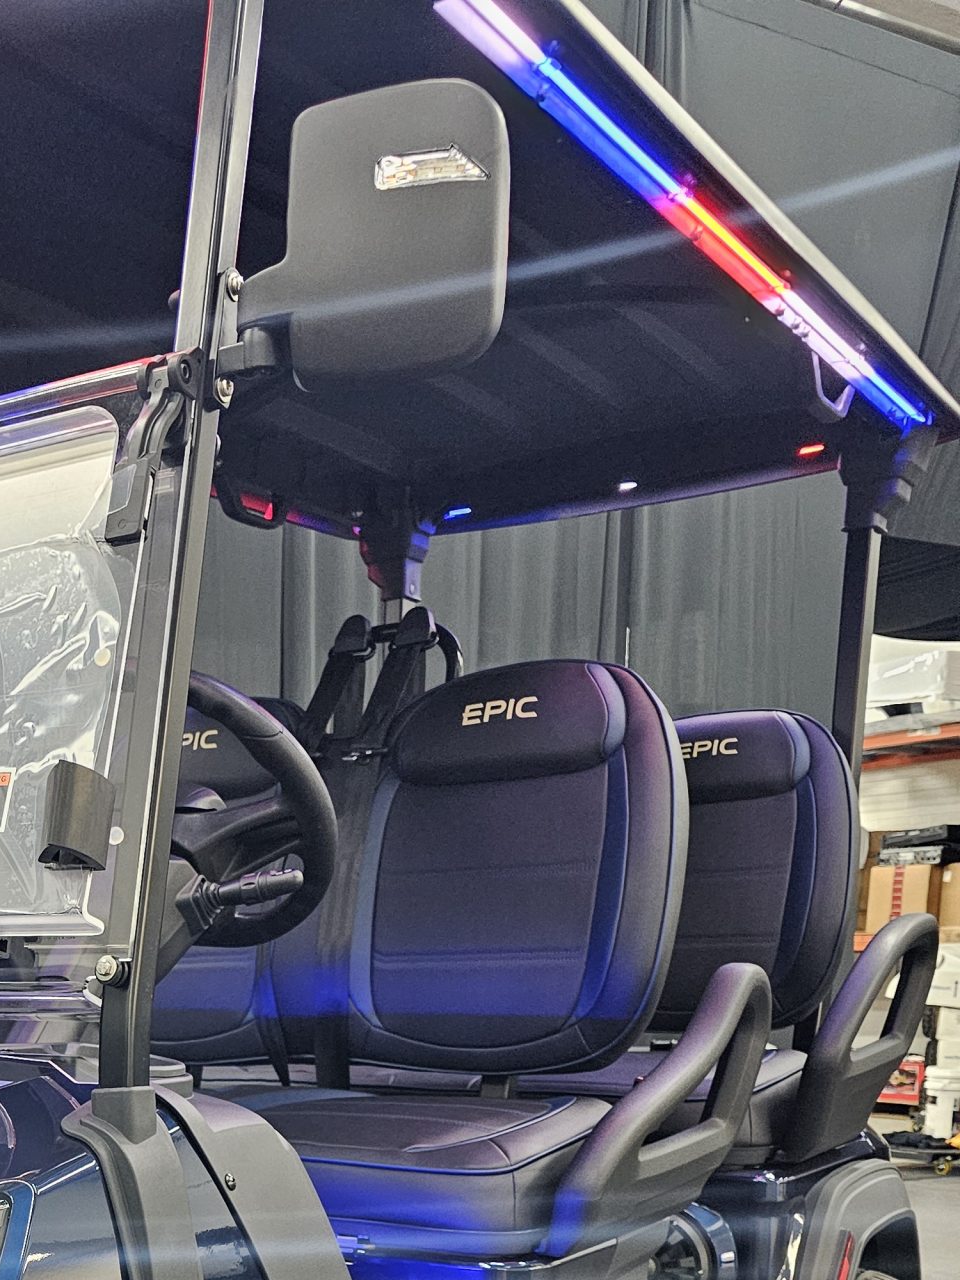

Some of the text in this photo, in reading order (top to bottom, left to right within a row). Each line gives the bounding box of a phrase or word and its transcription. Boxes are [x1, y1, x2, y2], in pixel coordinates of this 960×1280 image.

[462, 696, 538, 726] EPIC
[182, 730, 218, 750] PIC
[680, 738, 738, 759] EPIC
